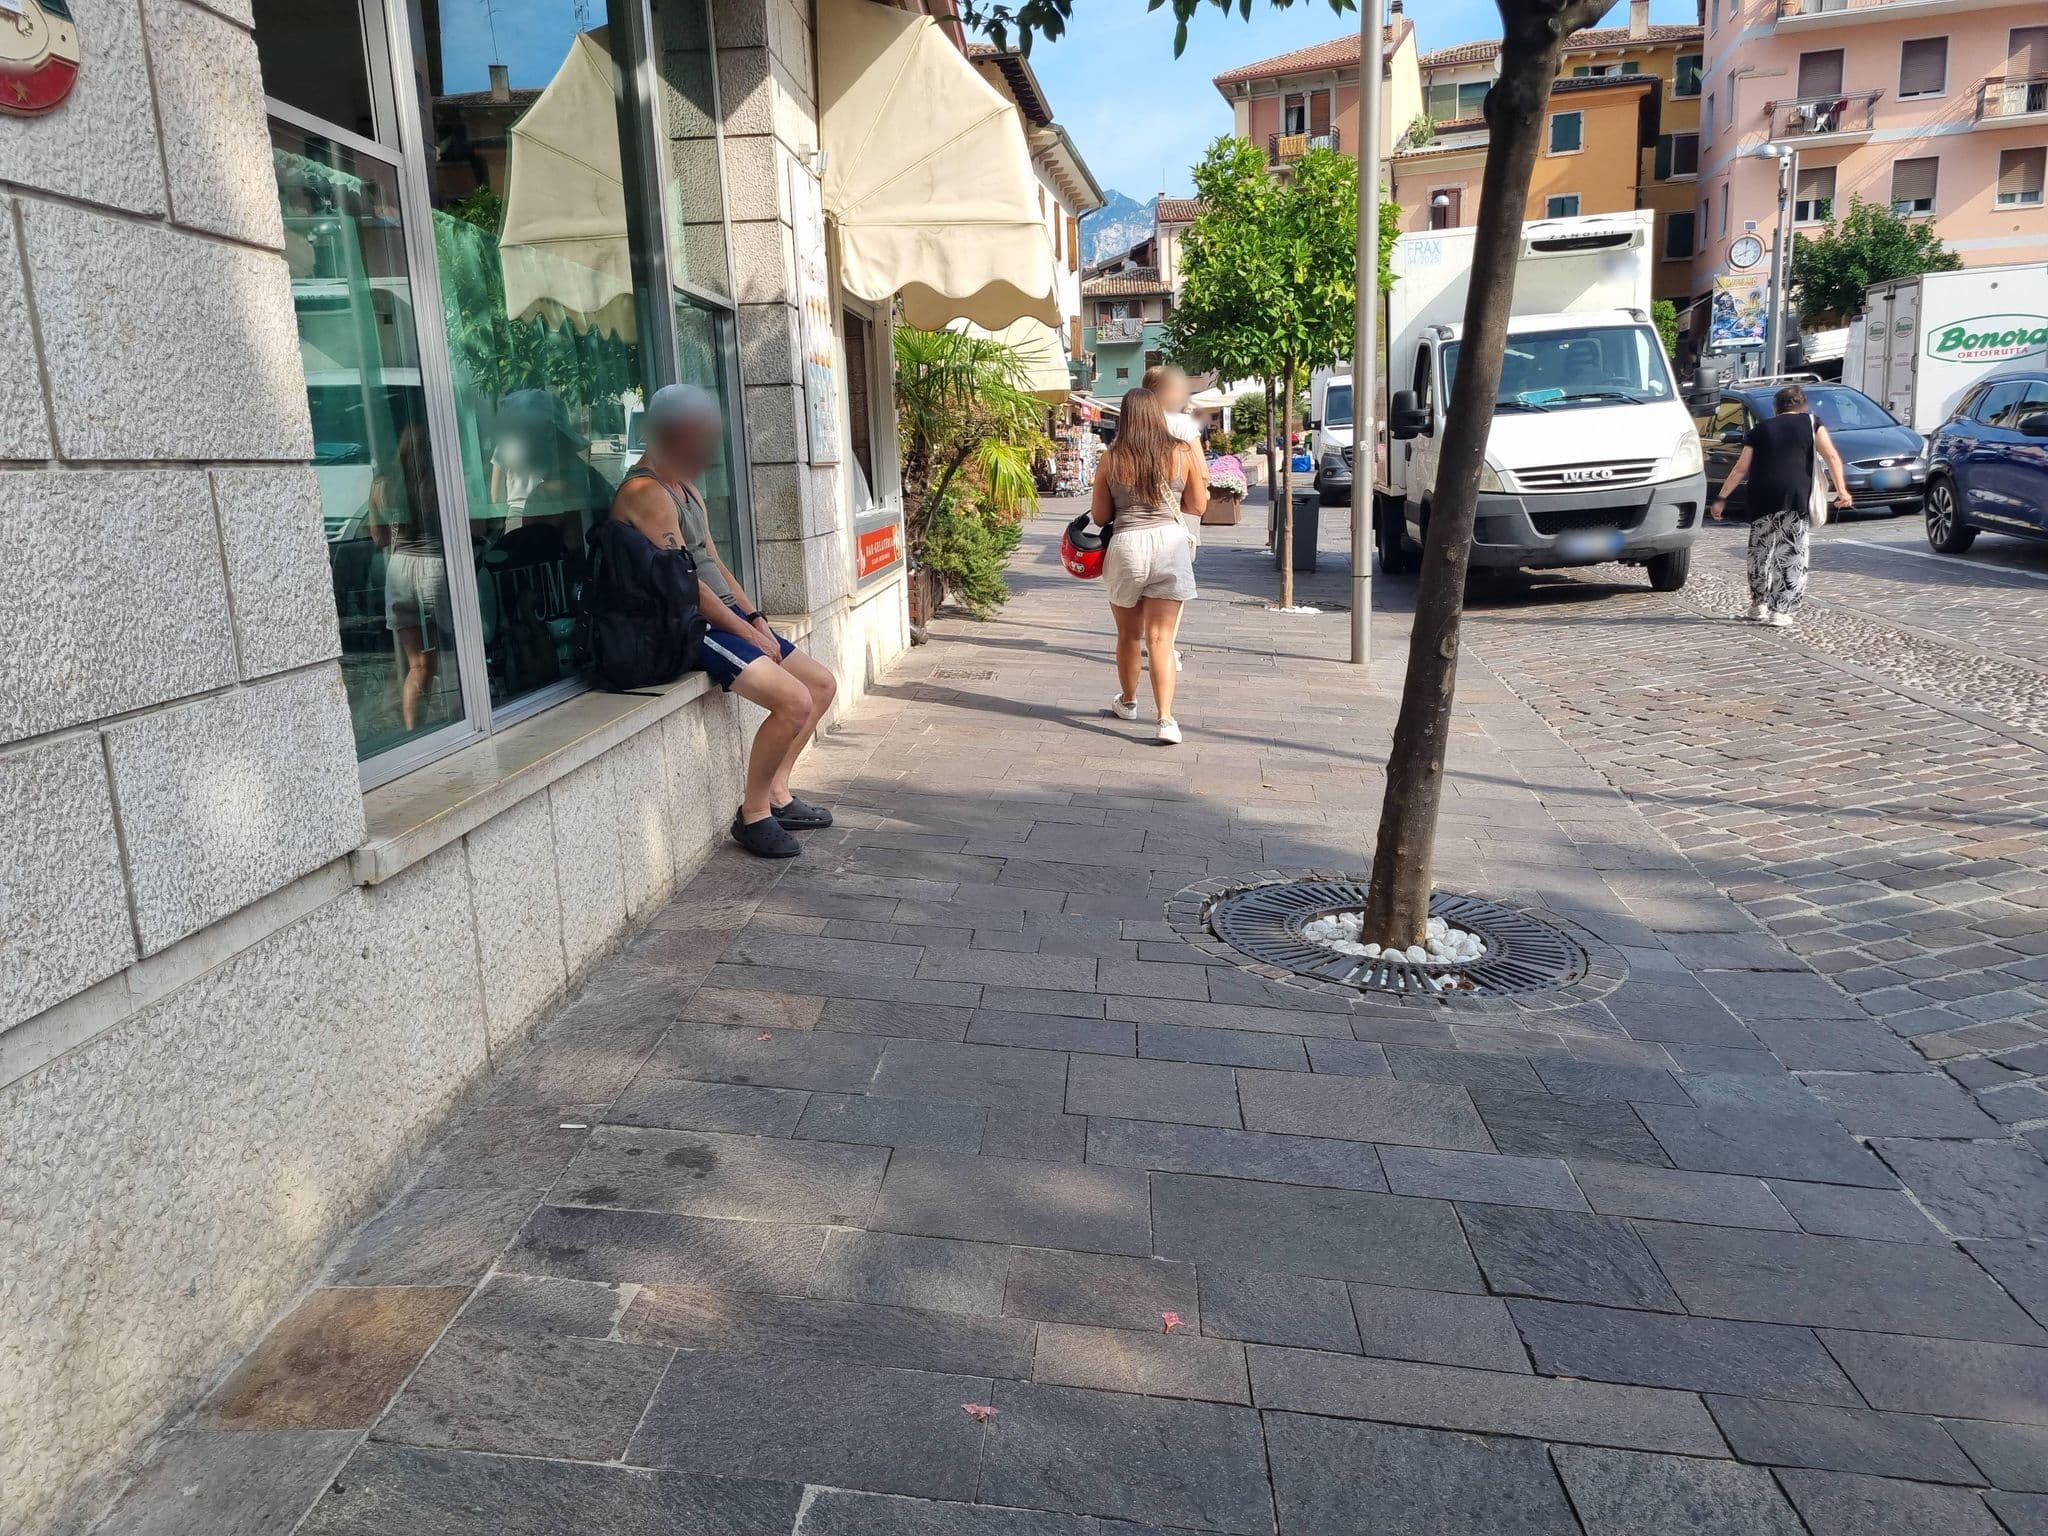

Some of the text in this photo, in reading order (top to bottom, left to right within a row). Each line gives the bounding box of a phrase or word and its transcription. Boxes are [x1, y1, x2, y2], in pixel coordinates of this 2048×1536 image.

[1407, 240, 1441, 256] FRAX
[1936, 327, 2048, 353] Bonora
[1957, 347, 2030, 359] ORTOFRUTTA
[1563, 470, 1613, 483] IVECO
